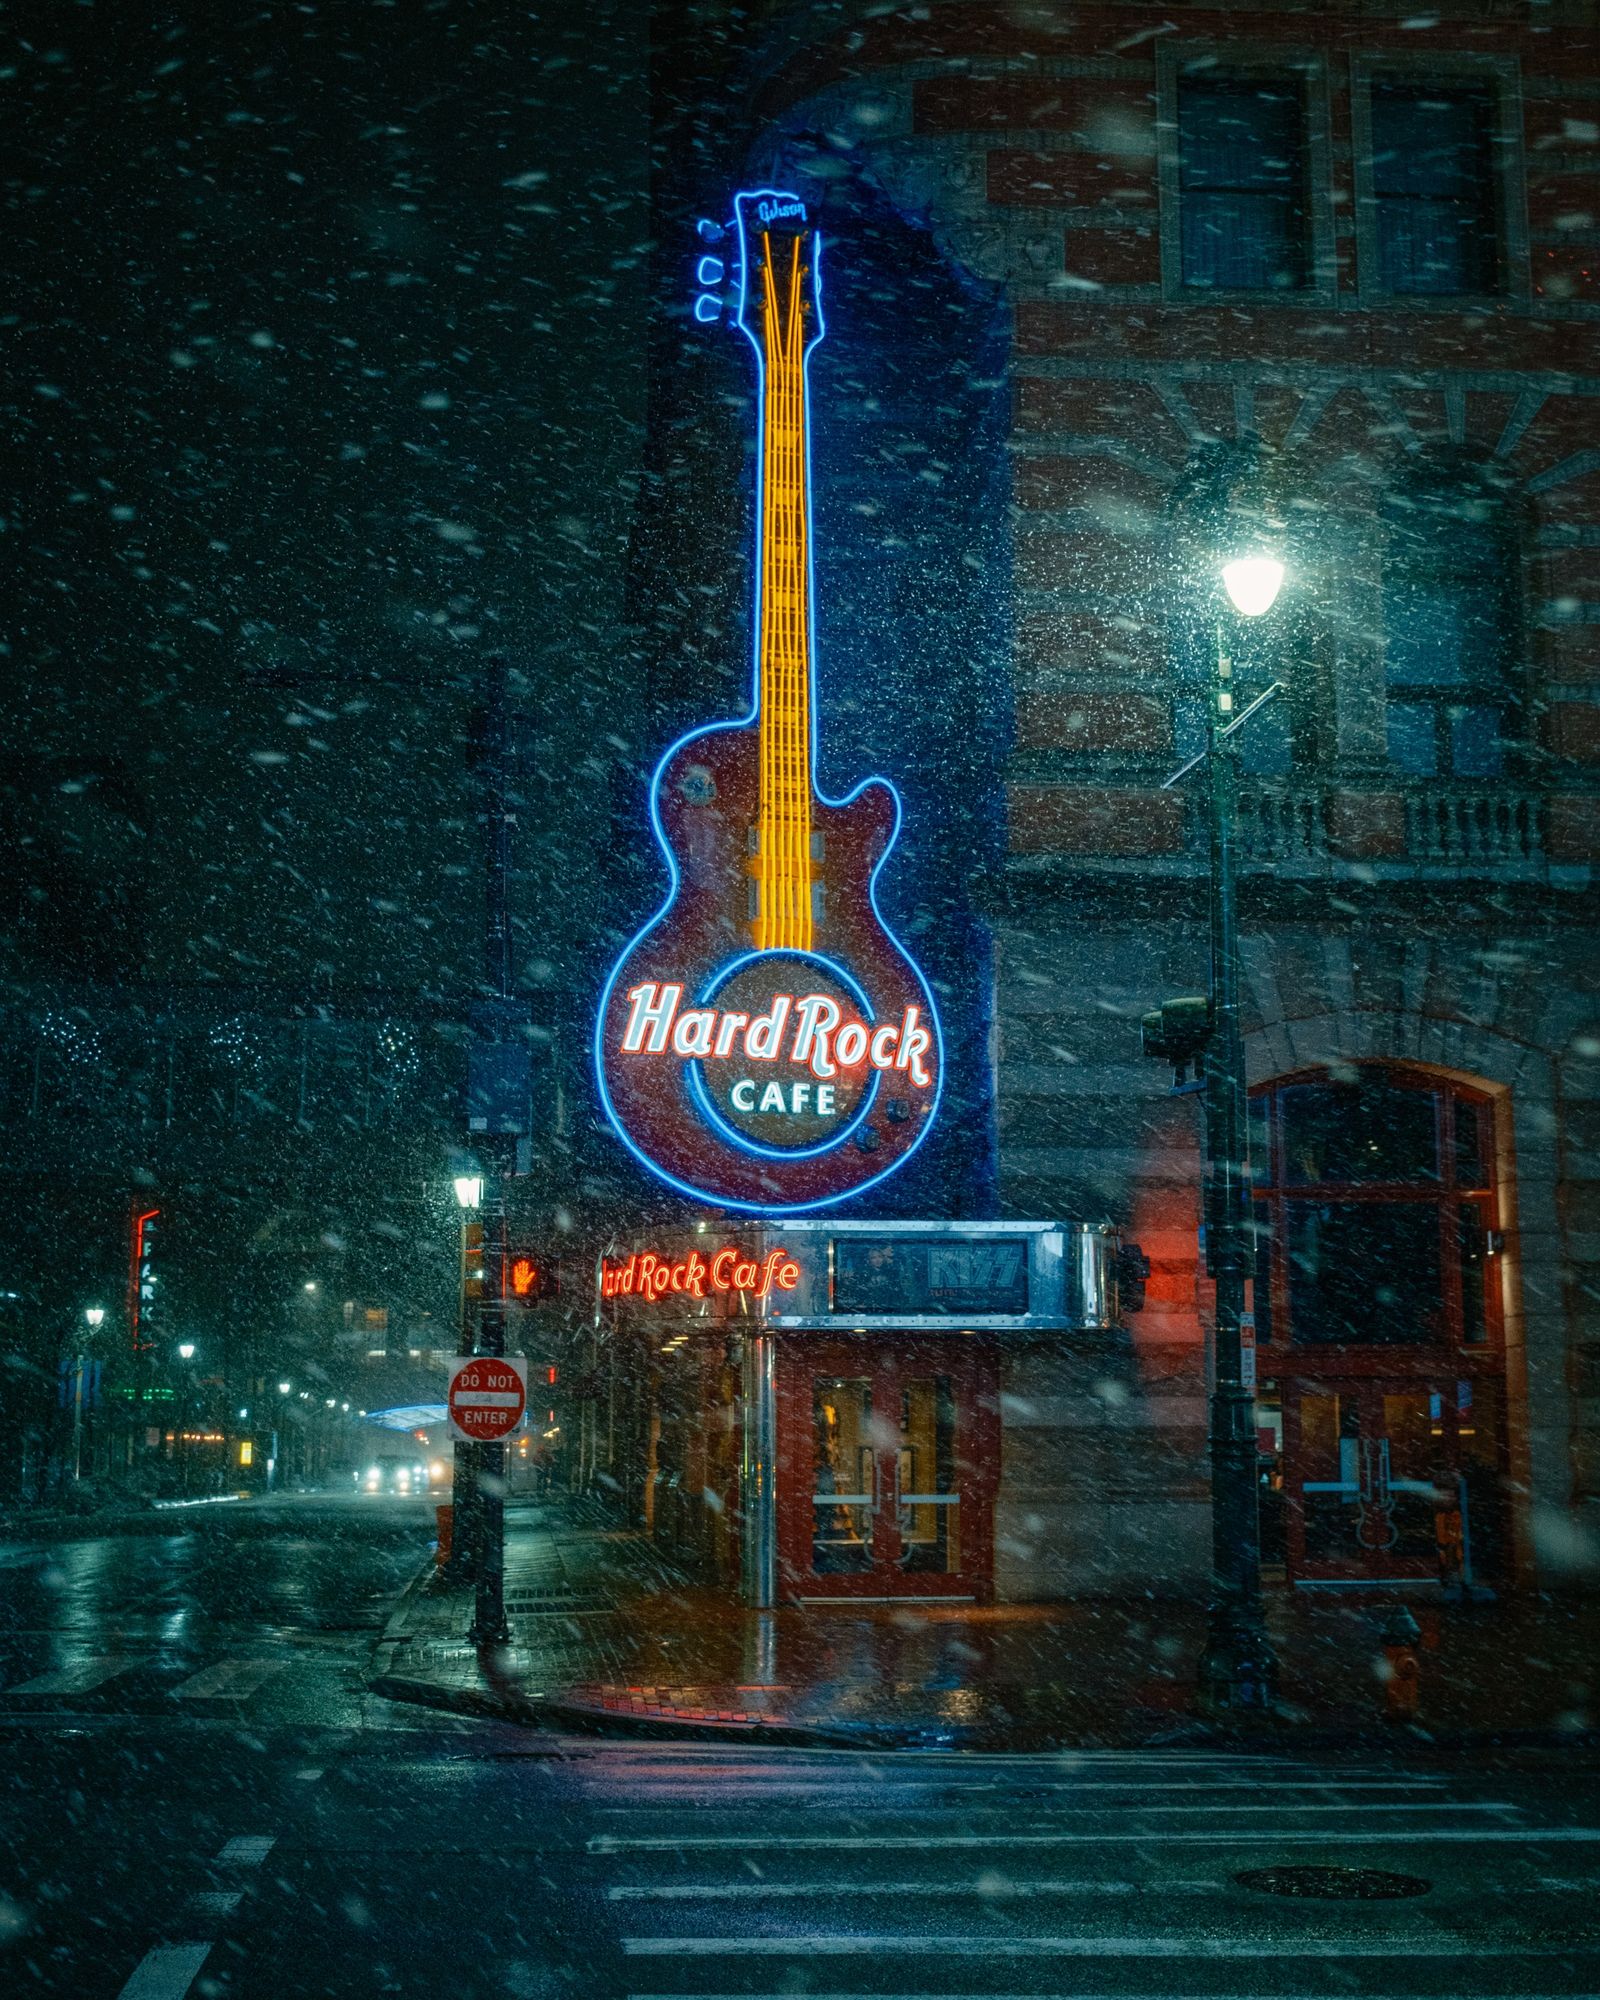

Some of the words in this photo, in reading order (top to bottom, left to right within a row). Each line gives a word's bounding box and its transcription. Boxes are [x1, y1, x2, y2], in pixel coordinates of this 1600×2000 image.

[621, 981, 792, 1061] Hard
[789, 993, 933, 1088] Rock
[730, 1078, 837, 1116] CAFE
[636, 1250, 706, 1302] Rock
[711, 1248, 800, 1299] Cafe
[927, 1247, 1022, 1288] KISS
[461, 1375, 480, 1387] DO
[487, 1376, 514, 1388] NOT
[465, 1411, 507, 1424] ENTER
